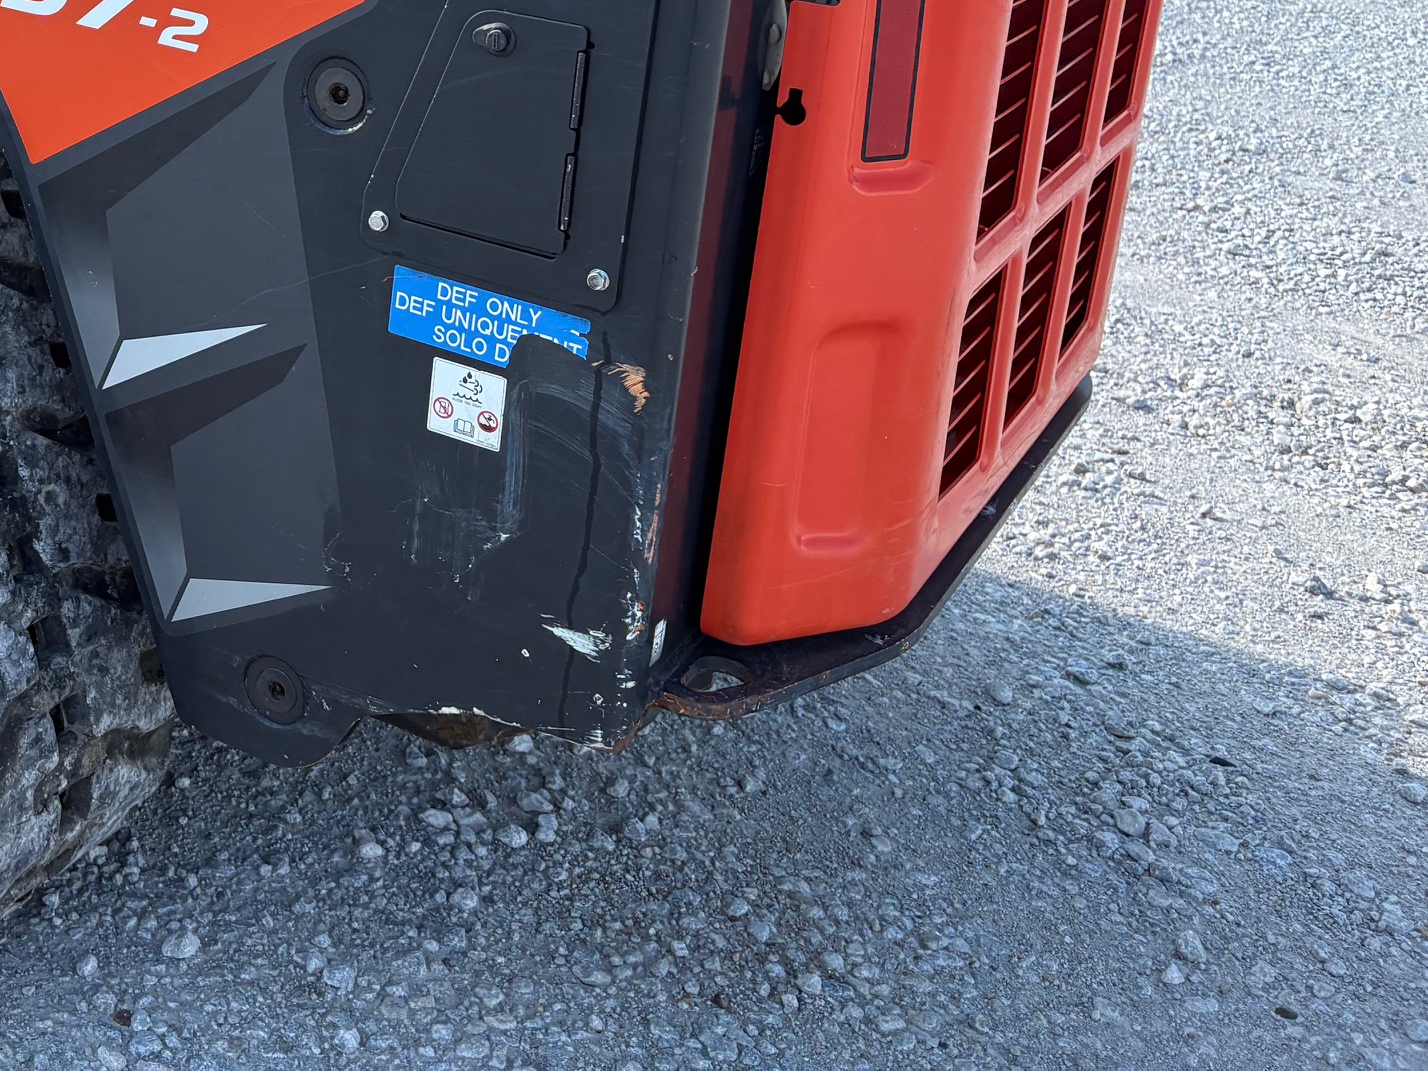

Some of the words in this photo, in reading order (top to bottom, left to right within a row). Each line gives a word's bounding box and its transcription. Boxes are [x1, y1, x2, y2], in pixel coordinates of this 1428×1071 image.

[395, 291, 436, 316] DEF
[437, 282, 478, 307] DEF
[486, 297, 542, 327] ONLY
[432, 326, 487, 355] SOLO
